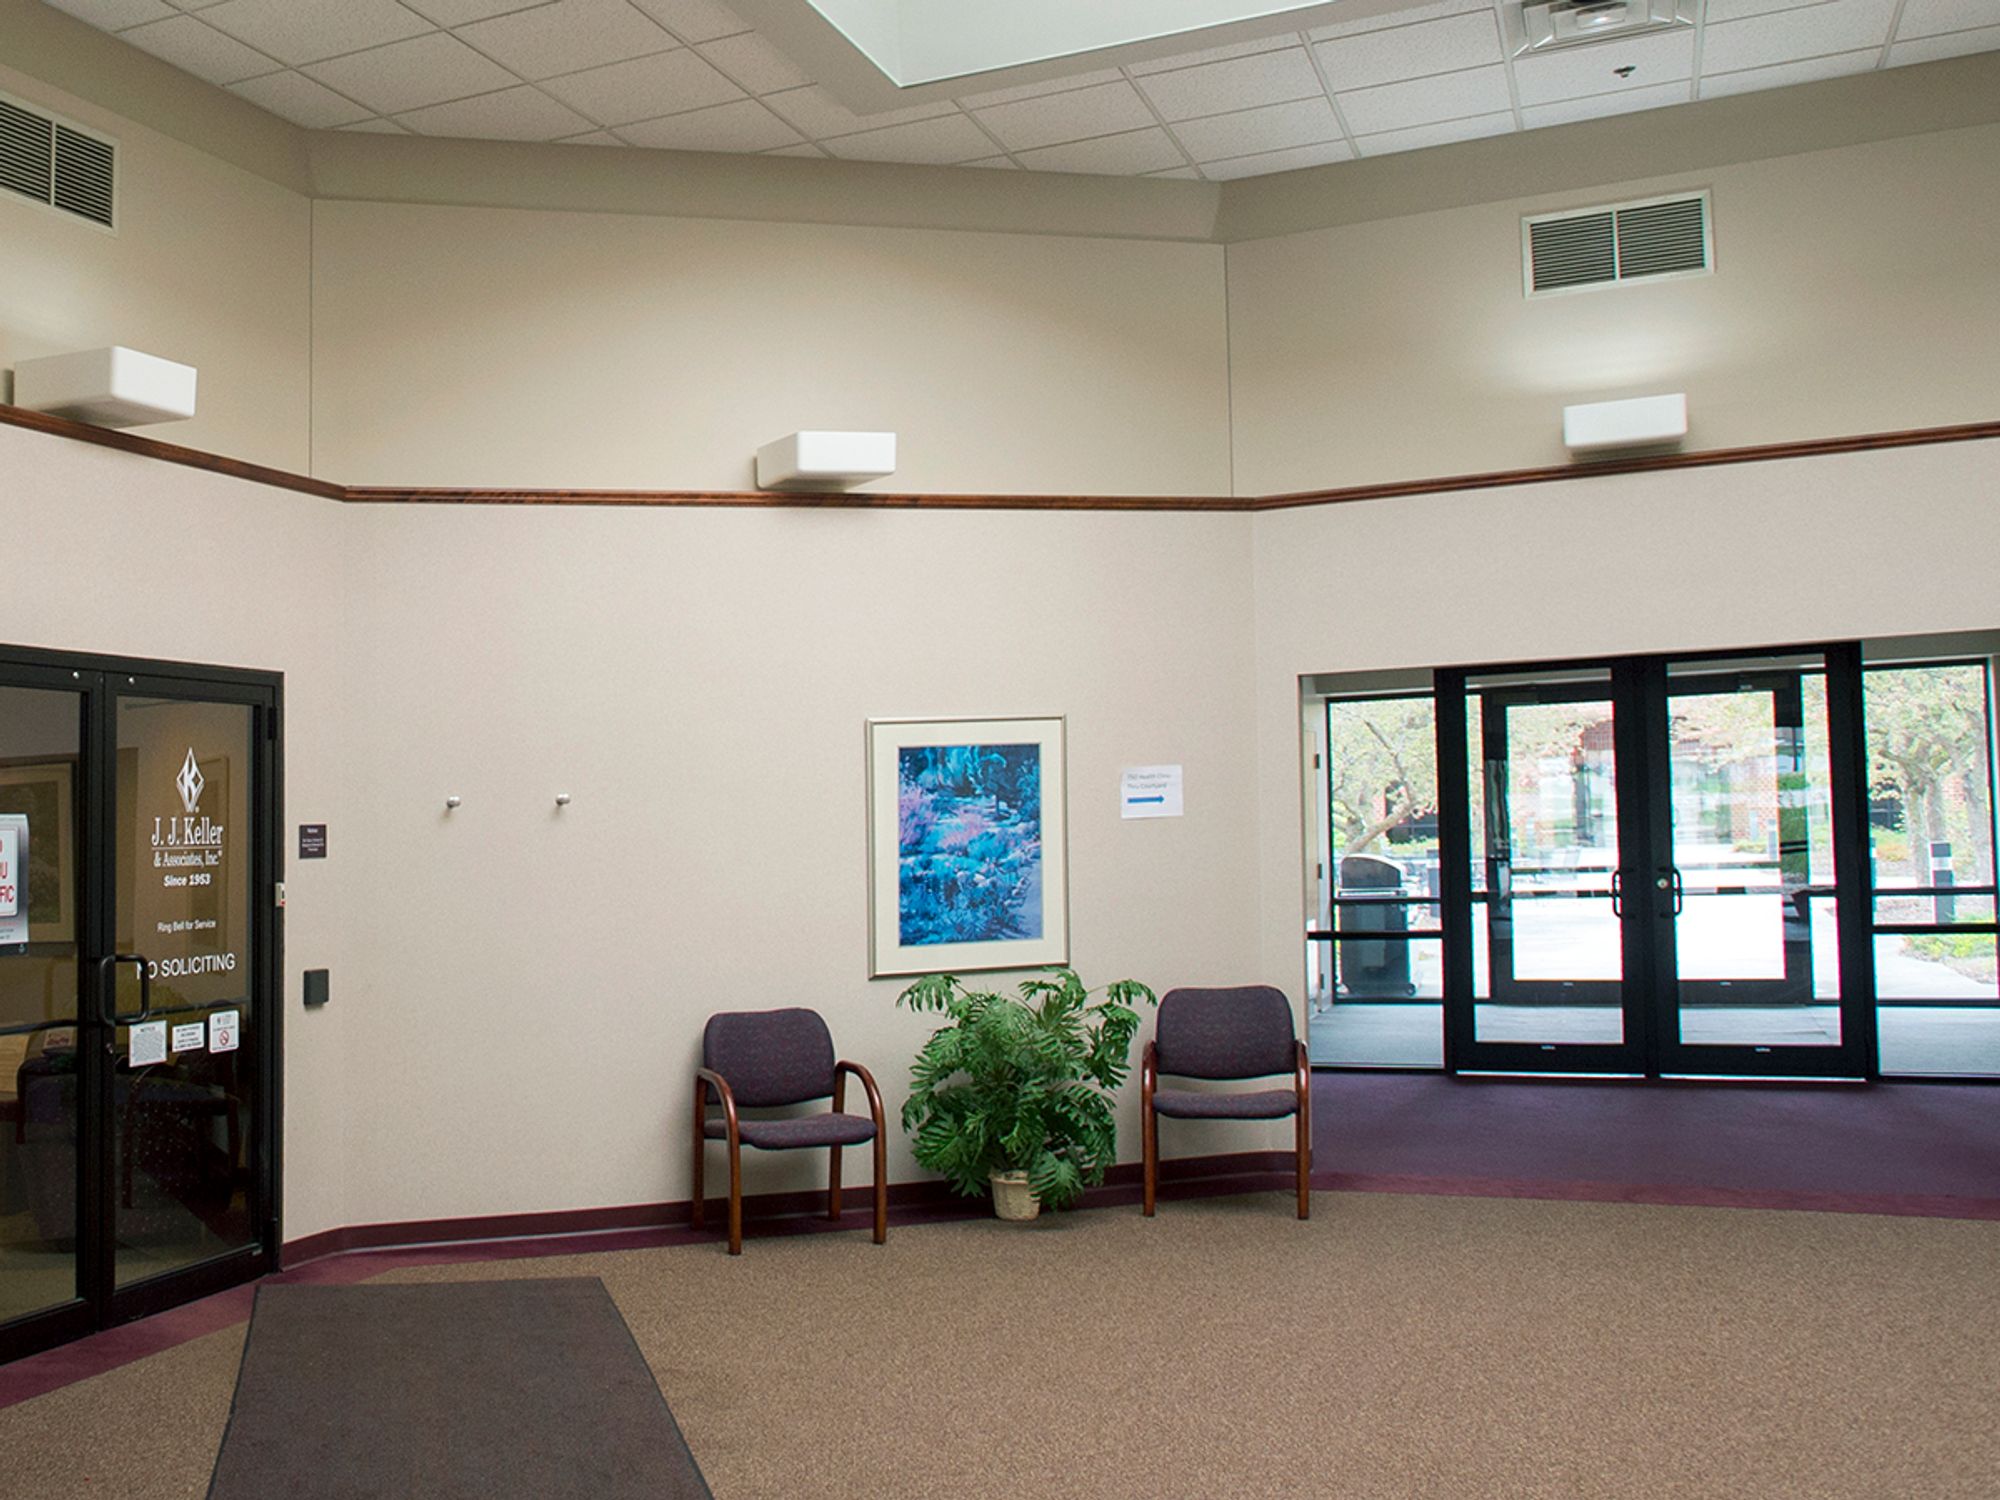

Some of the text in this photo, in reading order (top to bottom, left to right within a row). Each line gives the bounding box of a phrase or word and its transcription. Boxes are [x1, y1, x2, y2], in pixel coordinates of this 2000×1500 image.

[151, 816, 223, 846] J. J. Keller
[153, 851, 161, 867] &
[164, 875, 187, 887] Since
[161, 953, 235, 977] SOLICITING
